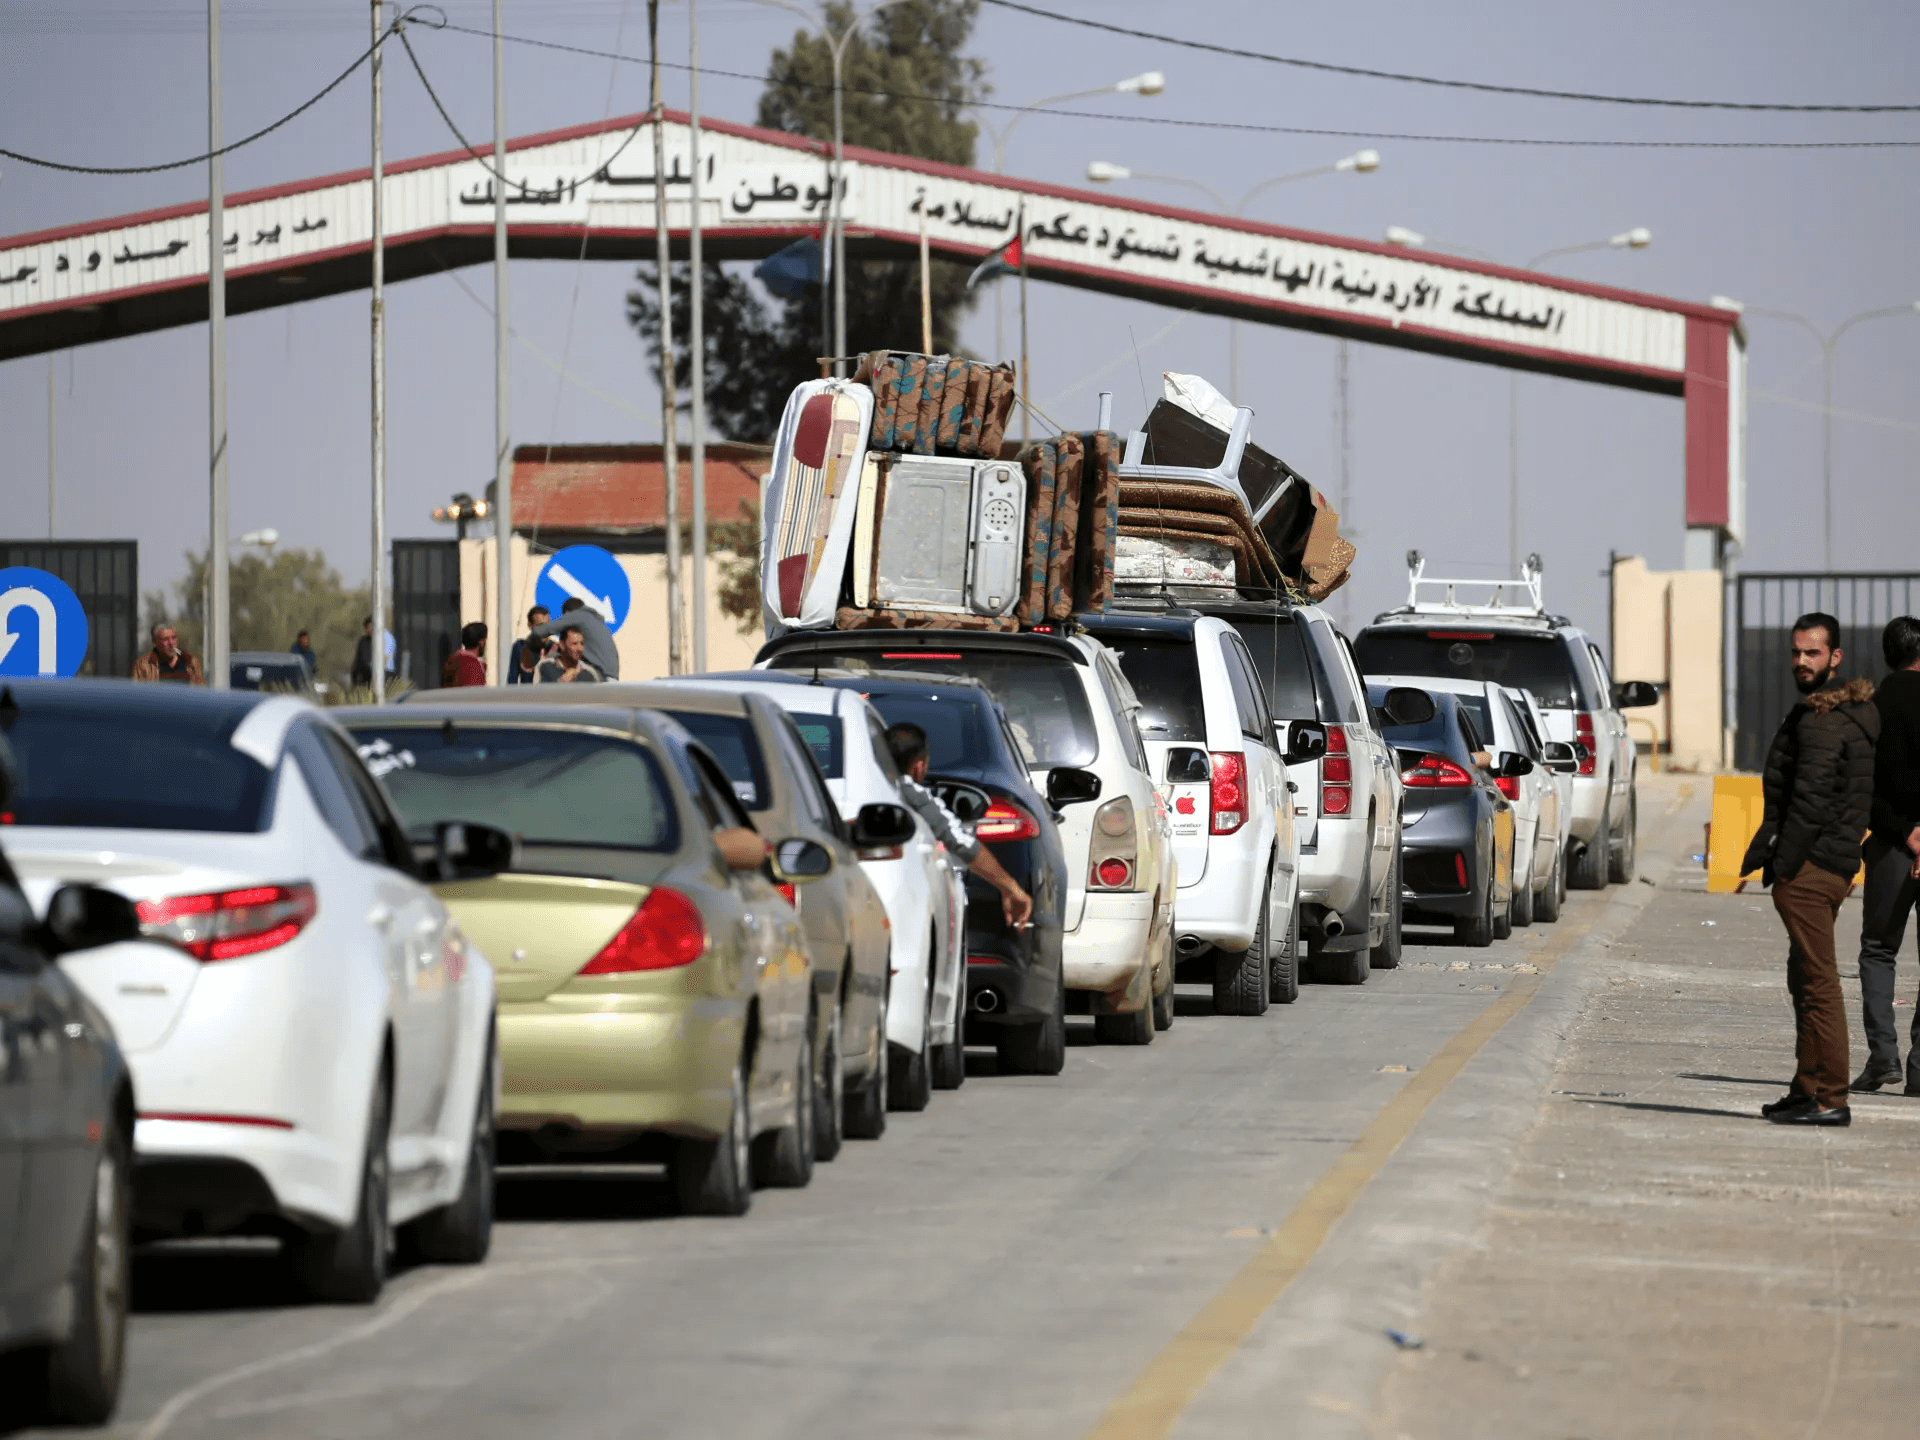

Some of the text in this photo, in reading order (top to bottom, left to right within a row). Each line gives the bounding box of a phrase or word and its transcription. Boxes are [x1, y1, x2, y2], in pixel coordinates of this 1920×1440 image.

[459, 176, 577, 205] الملك
[595, 154, 714, 185] اله
[731, 172, 848, 213] الوطن
[55, 216, 327, 272] مديري حدود
[1026, 212, 1182, 260] تستودعكم
[1193, 238, 1326, 292] الهاشمية
[1331, 260, 1440, 312] الأردنية
[1453, 284, 1565, 334] المملكة
